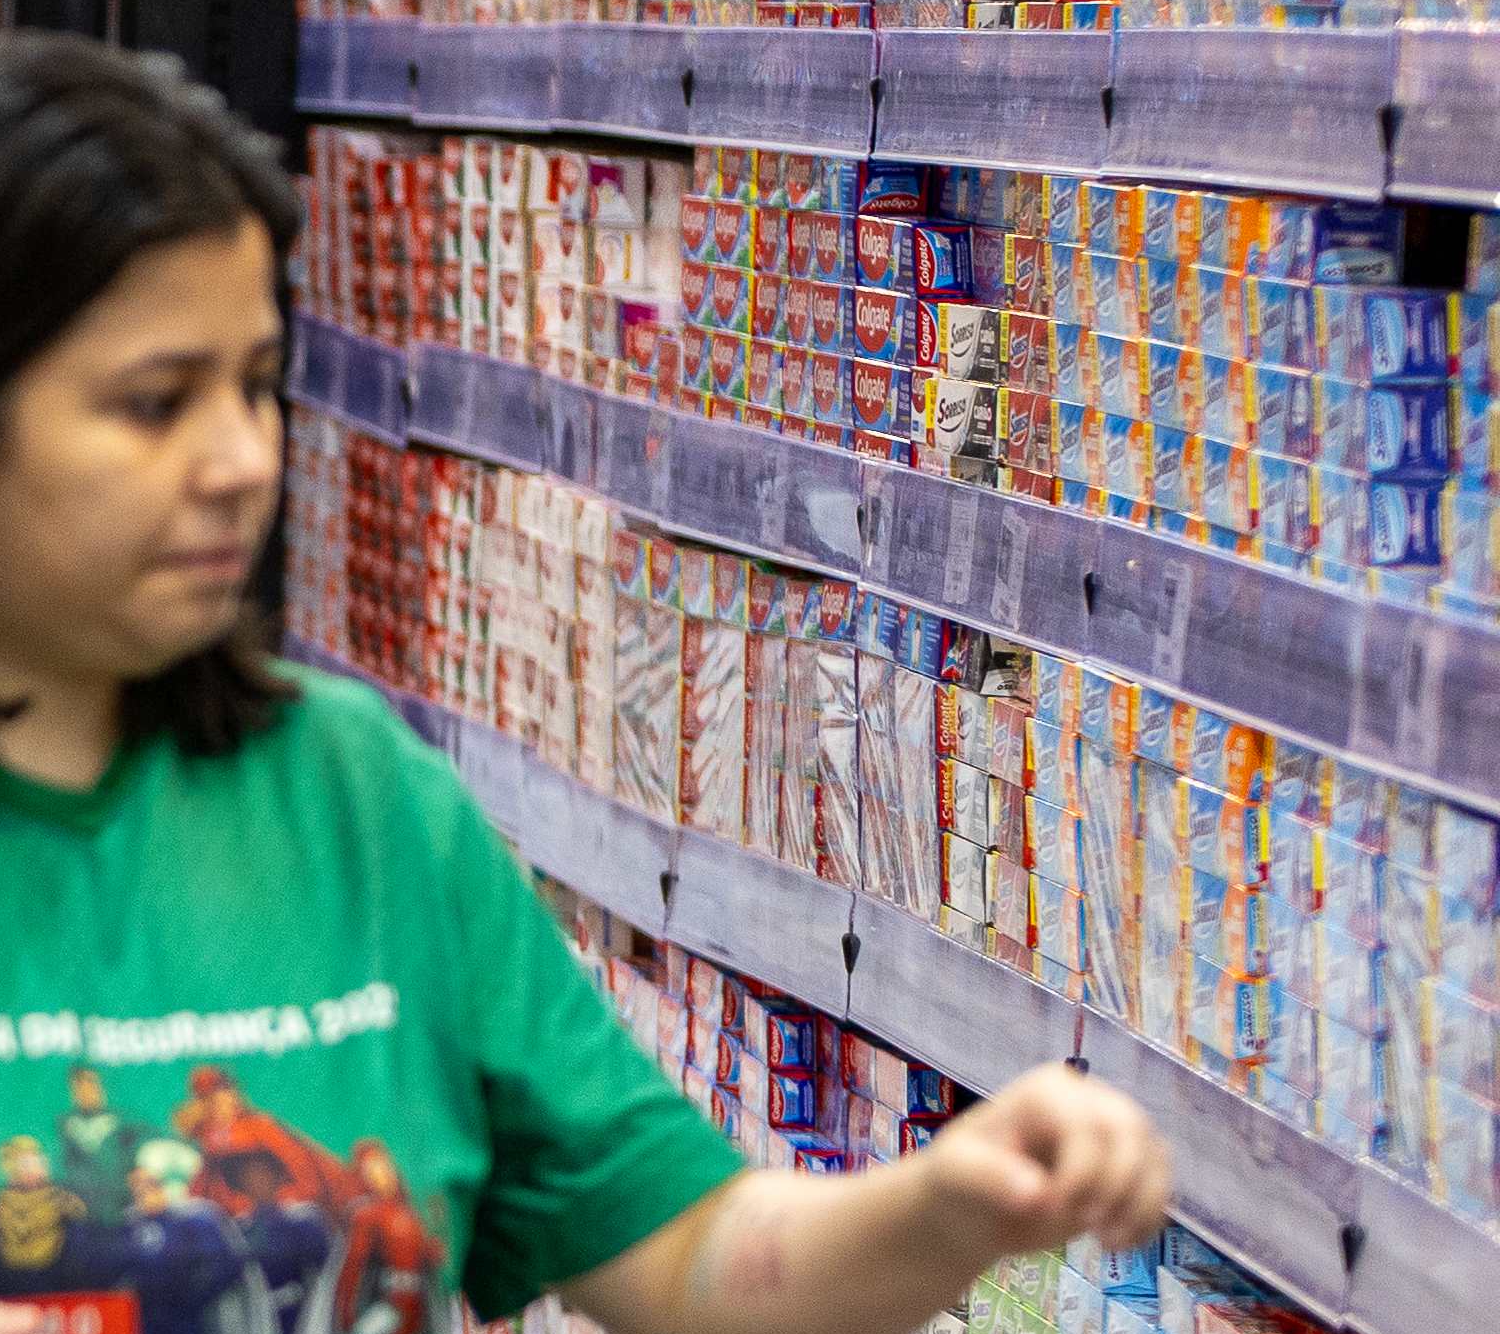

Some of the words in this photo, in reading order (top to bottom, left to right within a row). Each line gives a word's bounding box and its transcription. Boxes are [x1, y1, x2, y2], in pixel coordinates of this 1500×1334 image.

[871, 198, 919, 211] Colgate
[859, 225, 891, 264] Colgate
[920, 237, 930, 288] Colgate
[856, 297, 892, 337] Colgate
[950, 320, 975, 345] SORRISO
[920, 312, 930, 361] Colgate
[854, 369, 886, 407] Colgate
[937, 396, 967, 421] SORRISO
